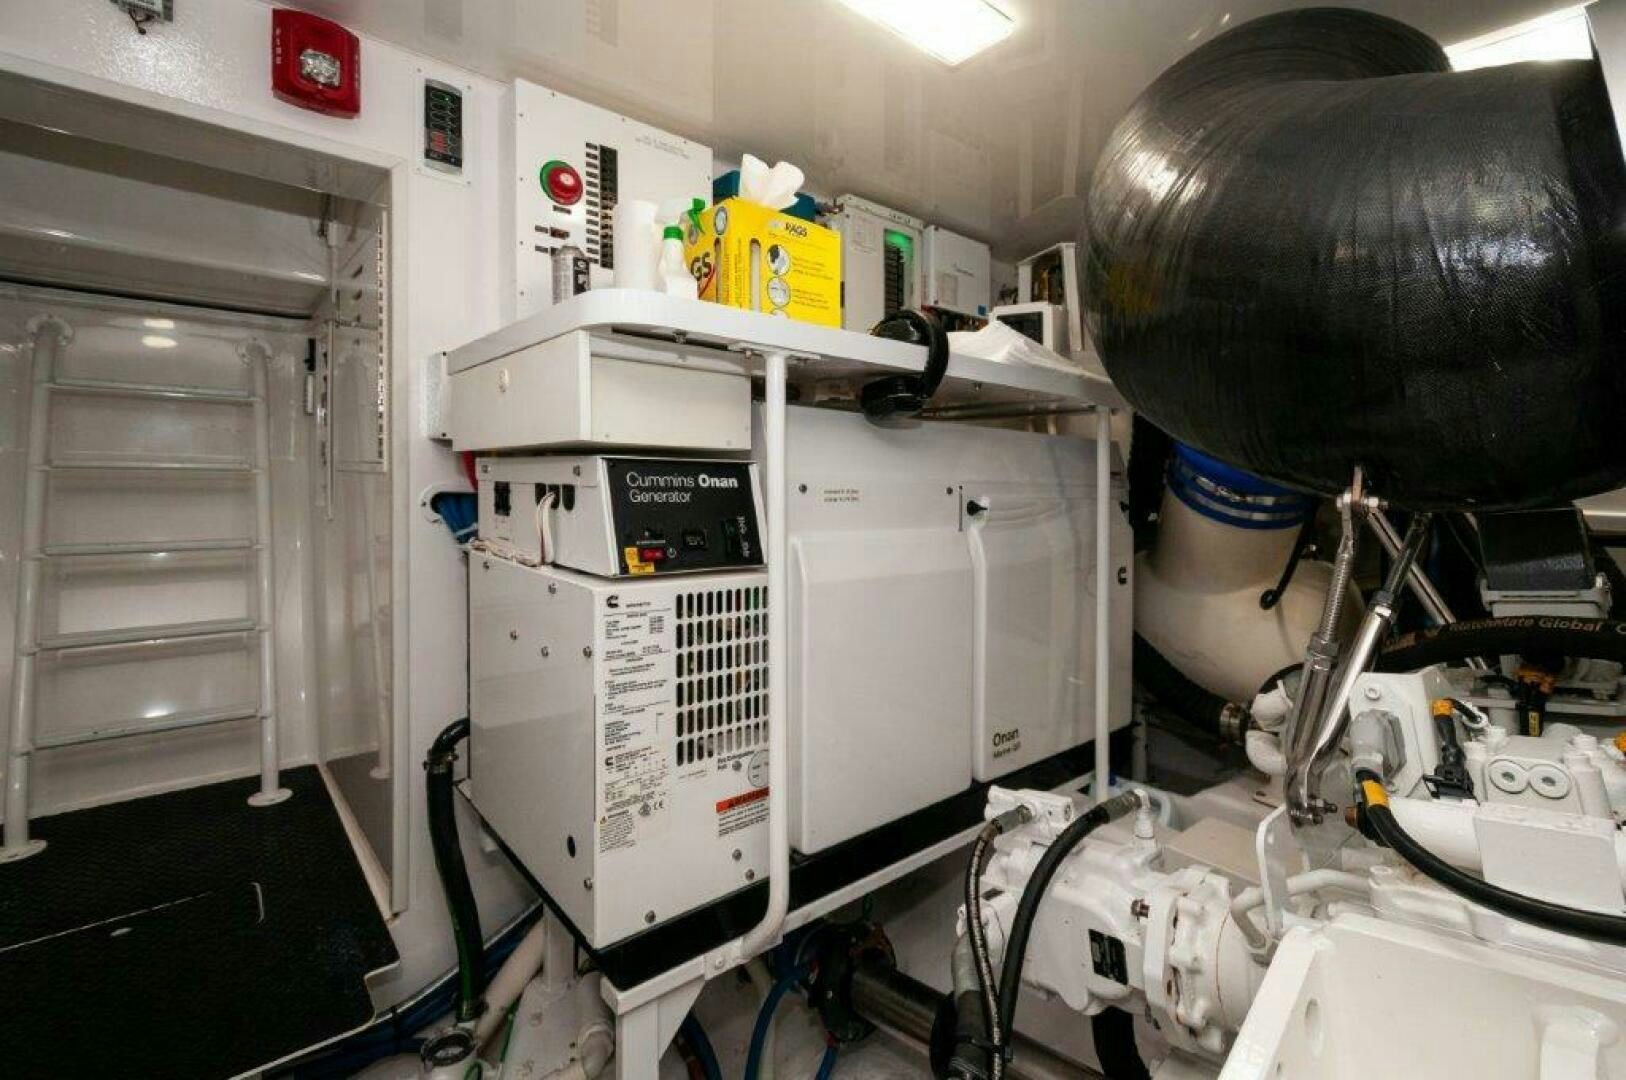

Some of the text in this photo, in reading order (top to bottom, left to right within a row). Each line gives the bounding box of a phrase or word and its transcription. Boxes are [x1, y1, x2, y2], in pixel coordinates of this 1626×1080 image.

[626, 471, 739, 489] Cummins Onan
[629, 488, 692, 504] Generator
[1539, 617, 1603, 633] Global
[993, 728, 1020, 748] Onan
